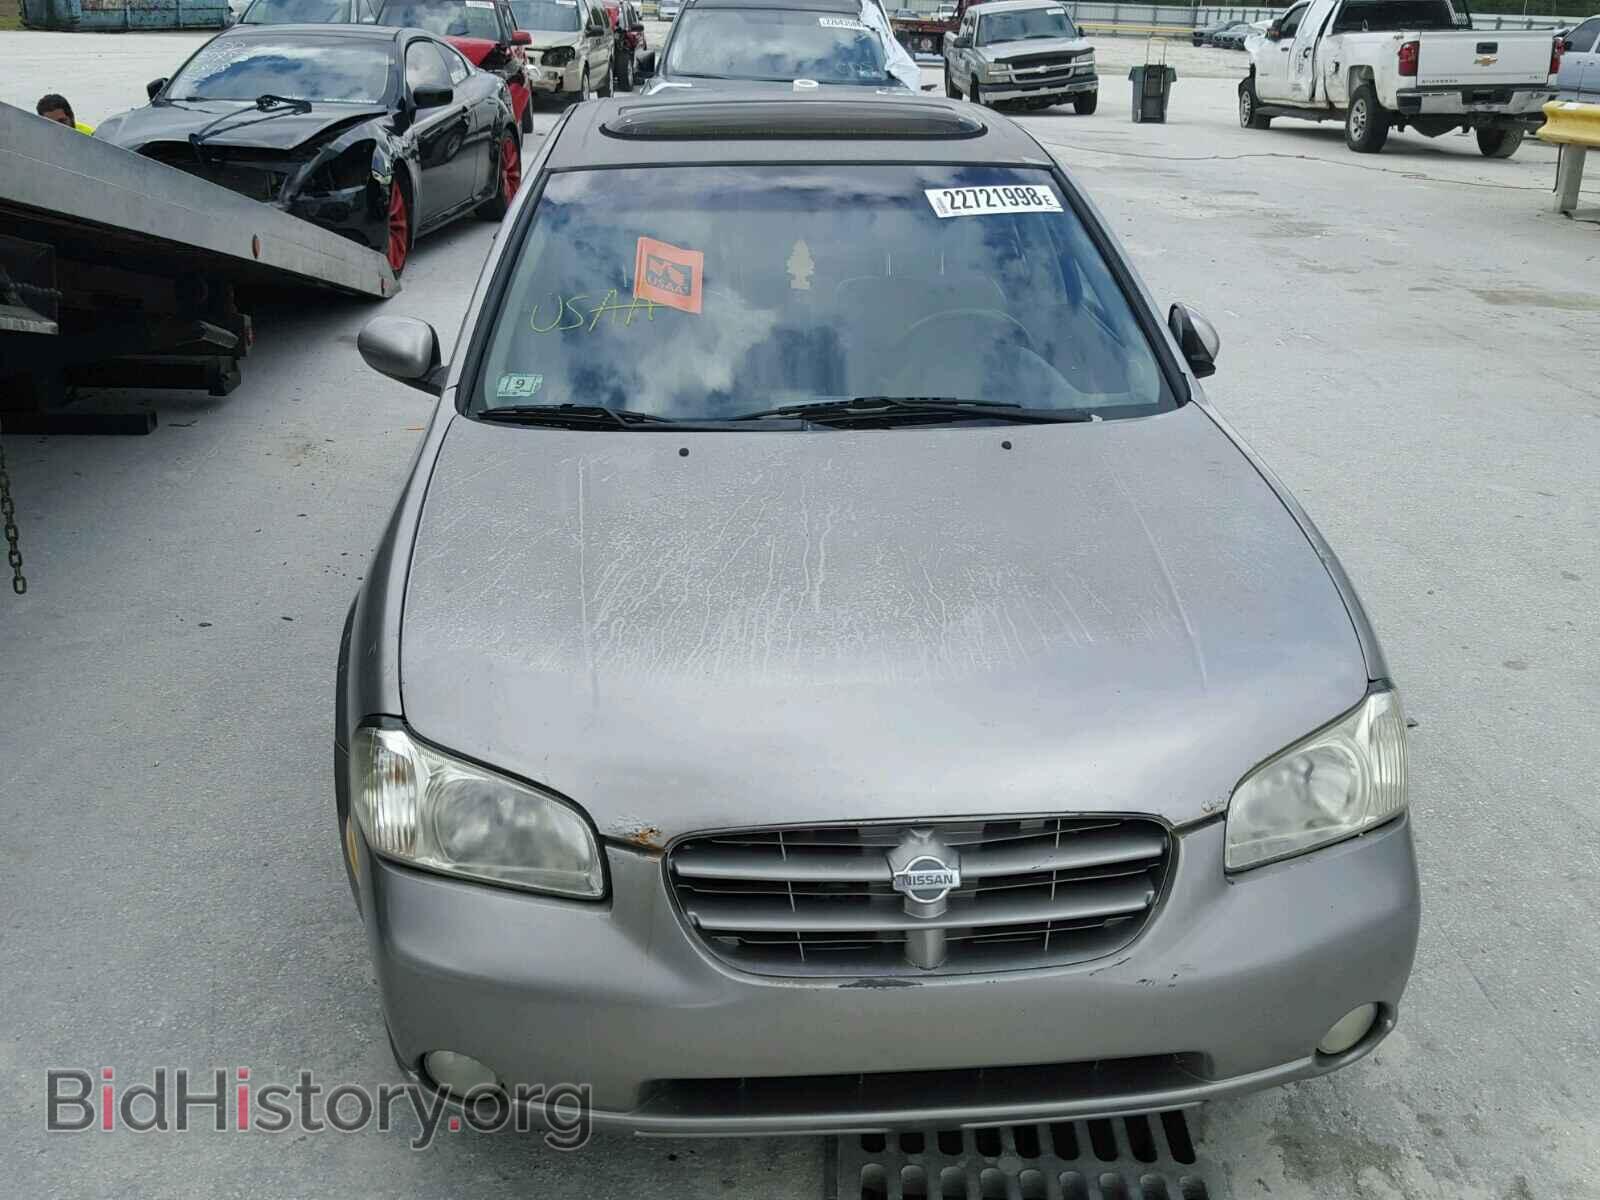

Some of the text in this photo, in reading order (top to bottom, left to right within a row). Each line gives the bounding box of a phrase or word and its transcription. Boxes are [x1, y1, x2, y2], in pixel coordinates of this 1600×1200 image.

[943, 187, 1043, 210] 22721998
[530, 289, 669, 333] USAA
[514, 379, 526, 389] 9
[903, 874, 953, 887] NISSAN
